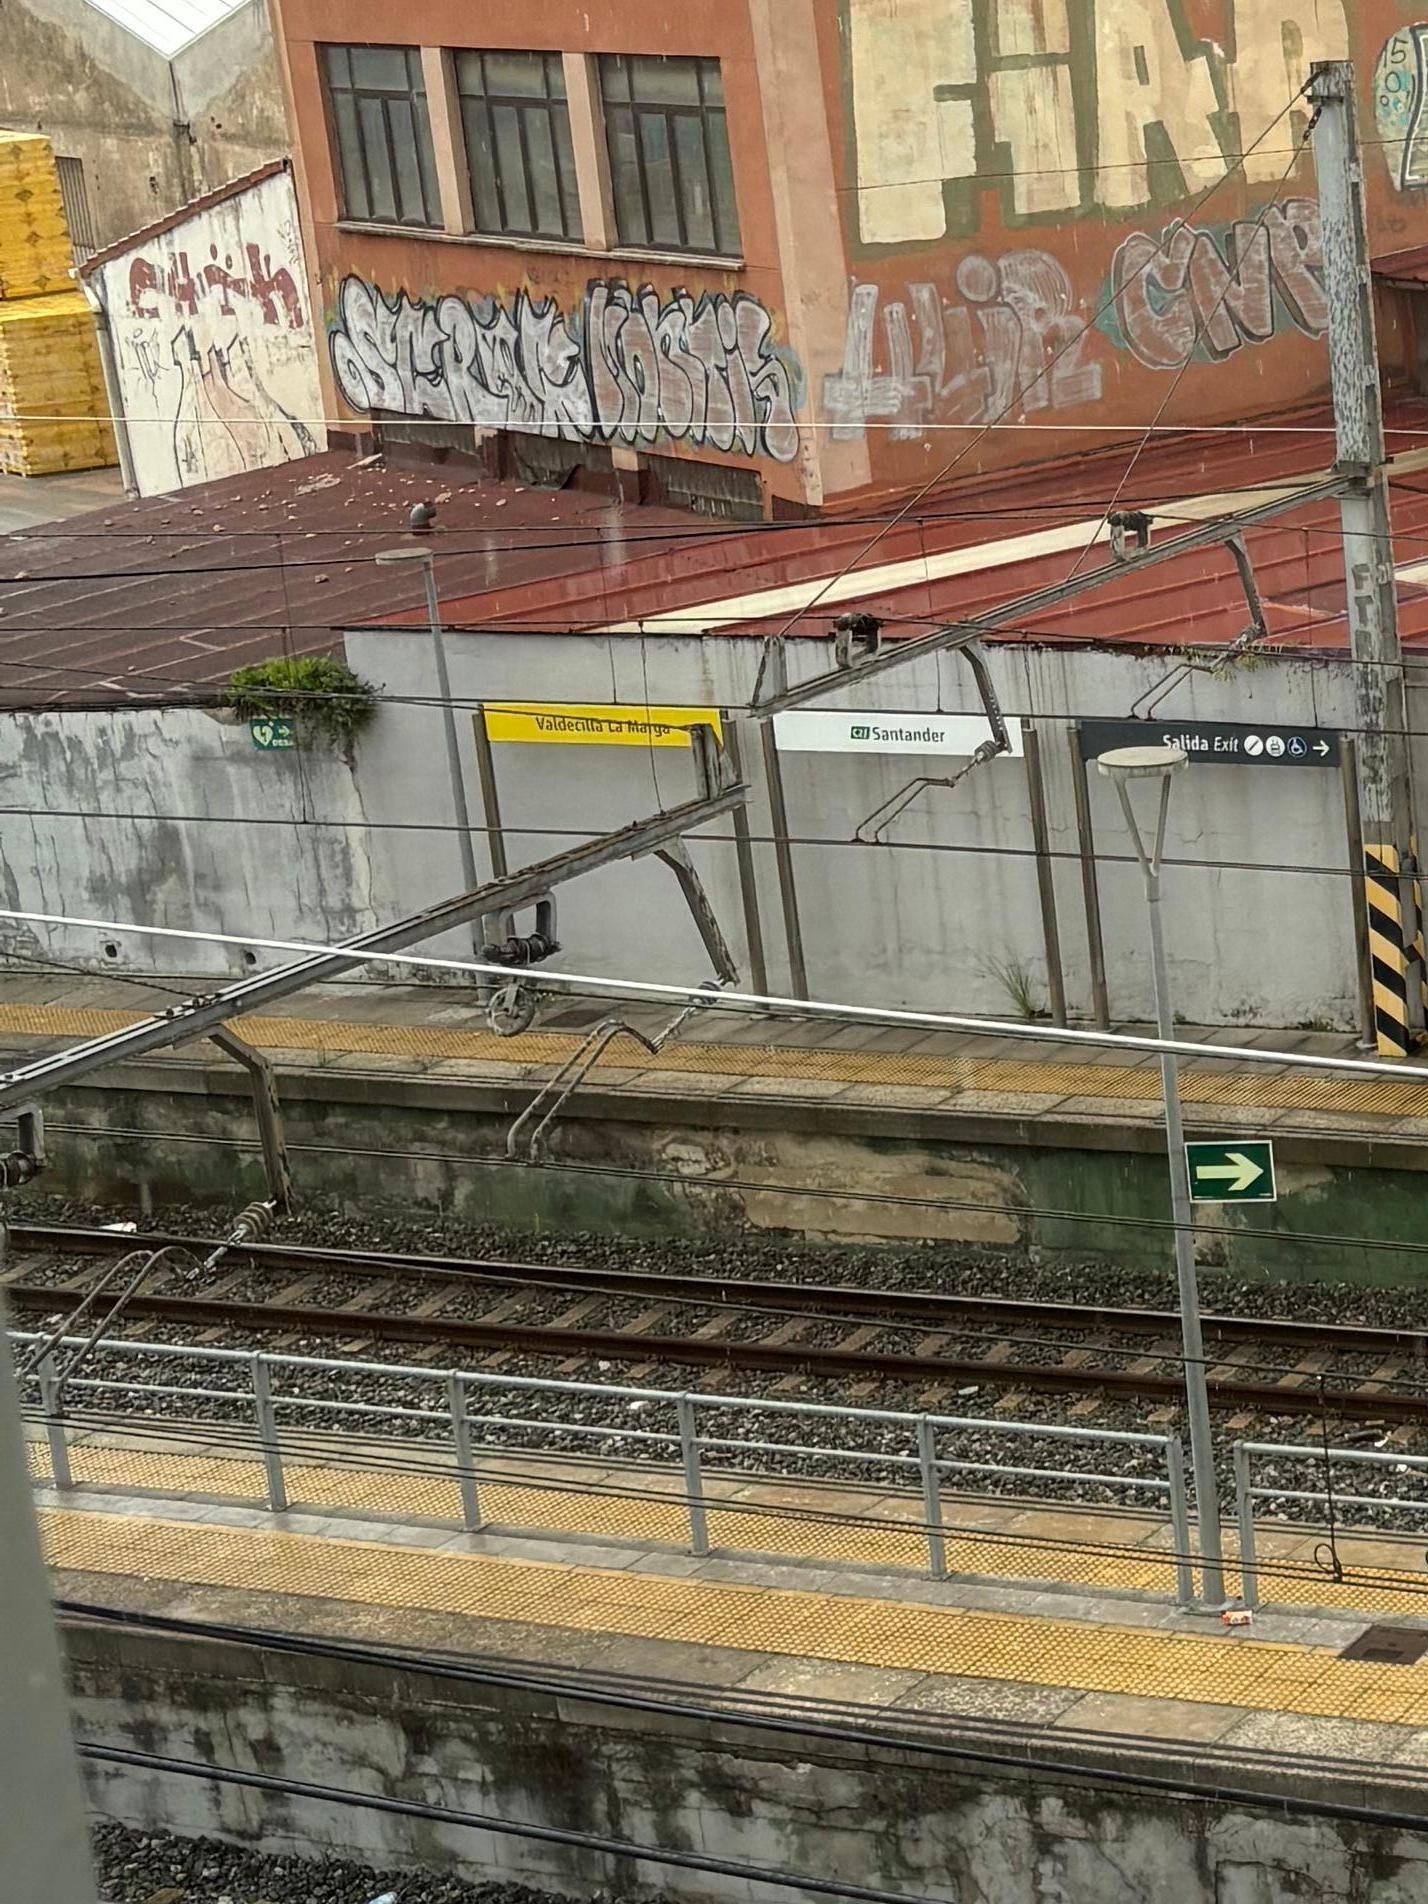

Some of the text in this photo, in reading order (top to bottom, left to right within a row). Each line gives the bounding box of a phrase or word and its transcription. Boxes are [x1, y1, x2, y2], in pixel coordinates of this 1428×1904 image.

[872, 726, 945, 743] Santander
[1162, 734, 1239, 753] Salida Exit
